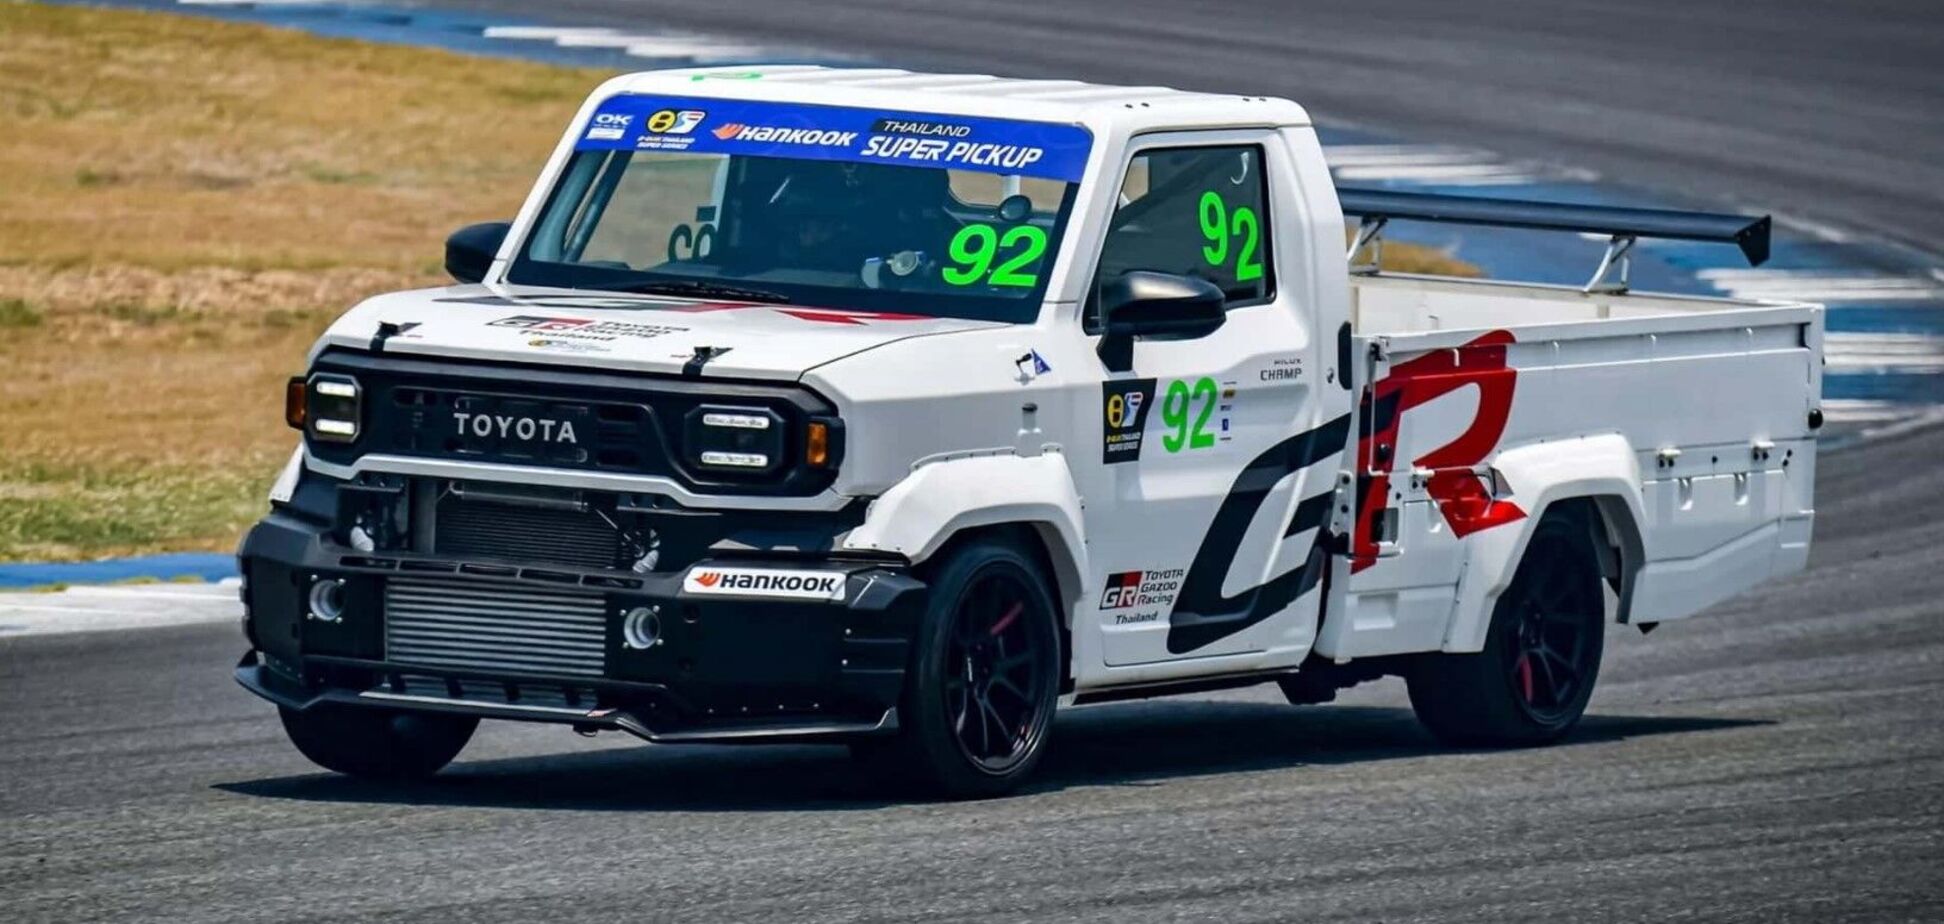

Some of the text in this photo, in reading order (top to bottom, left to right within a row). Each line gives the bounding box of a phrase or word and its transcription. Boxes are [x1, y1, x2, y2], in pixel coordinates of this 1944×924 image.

[596, 114, 634, 126] OK
[882, 120, 971, 137] THAILAND
[860, 136, 1044, 169] SUPER PICKUP
[1199, 191, 1264, 281] 92
[942, 224, 1048, 288] 92
[1260, 368, 1303, 381] CHAMP
[1163, 377, 1217, 453] 92
[453, 412, 577, 444] TOYOTA
[1145, 569, 1184, 581] TOYOTA
[1141, 581, 1177, 593] GAZOO
[1101, 585, 1138, 608] GR
[1137, 593, 1174, 606] Racing
[1115, 611, 1158, 624] Thailand
